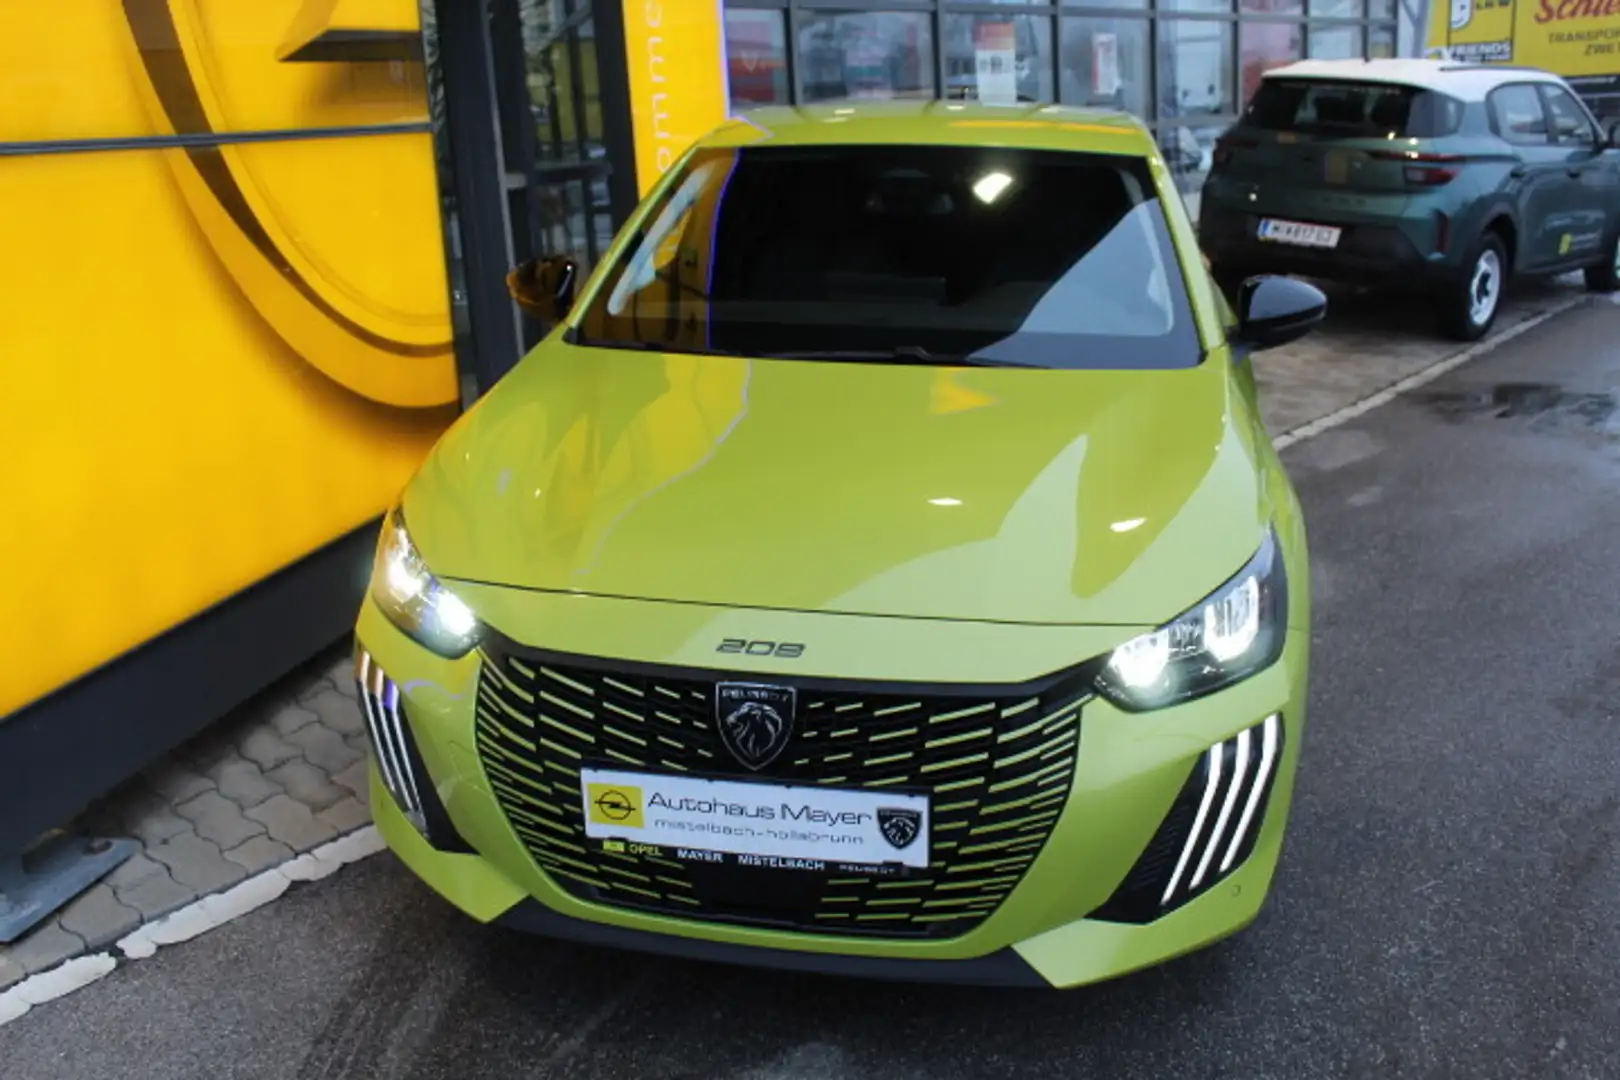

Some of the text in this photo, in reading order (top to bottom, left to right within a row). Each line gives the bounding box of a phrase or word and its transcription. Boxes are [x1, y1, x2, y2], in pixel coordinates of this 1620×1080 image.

[716, 638, 806, 658] 208
[648, 792, 872, 827] Autohaus Mayer
[629, 844, 663, 856] OPEL
[677, 849, 723, 863] MAYER
[738, 855, 825, 871] MISTELBACH
